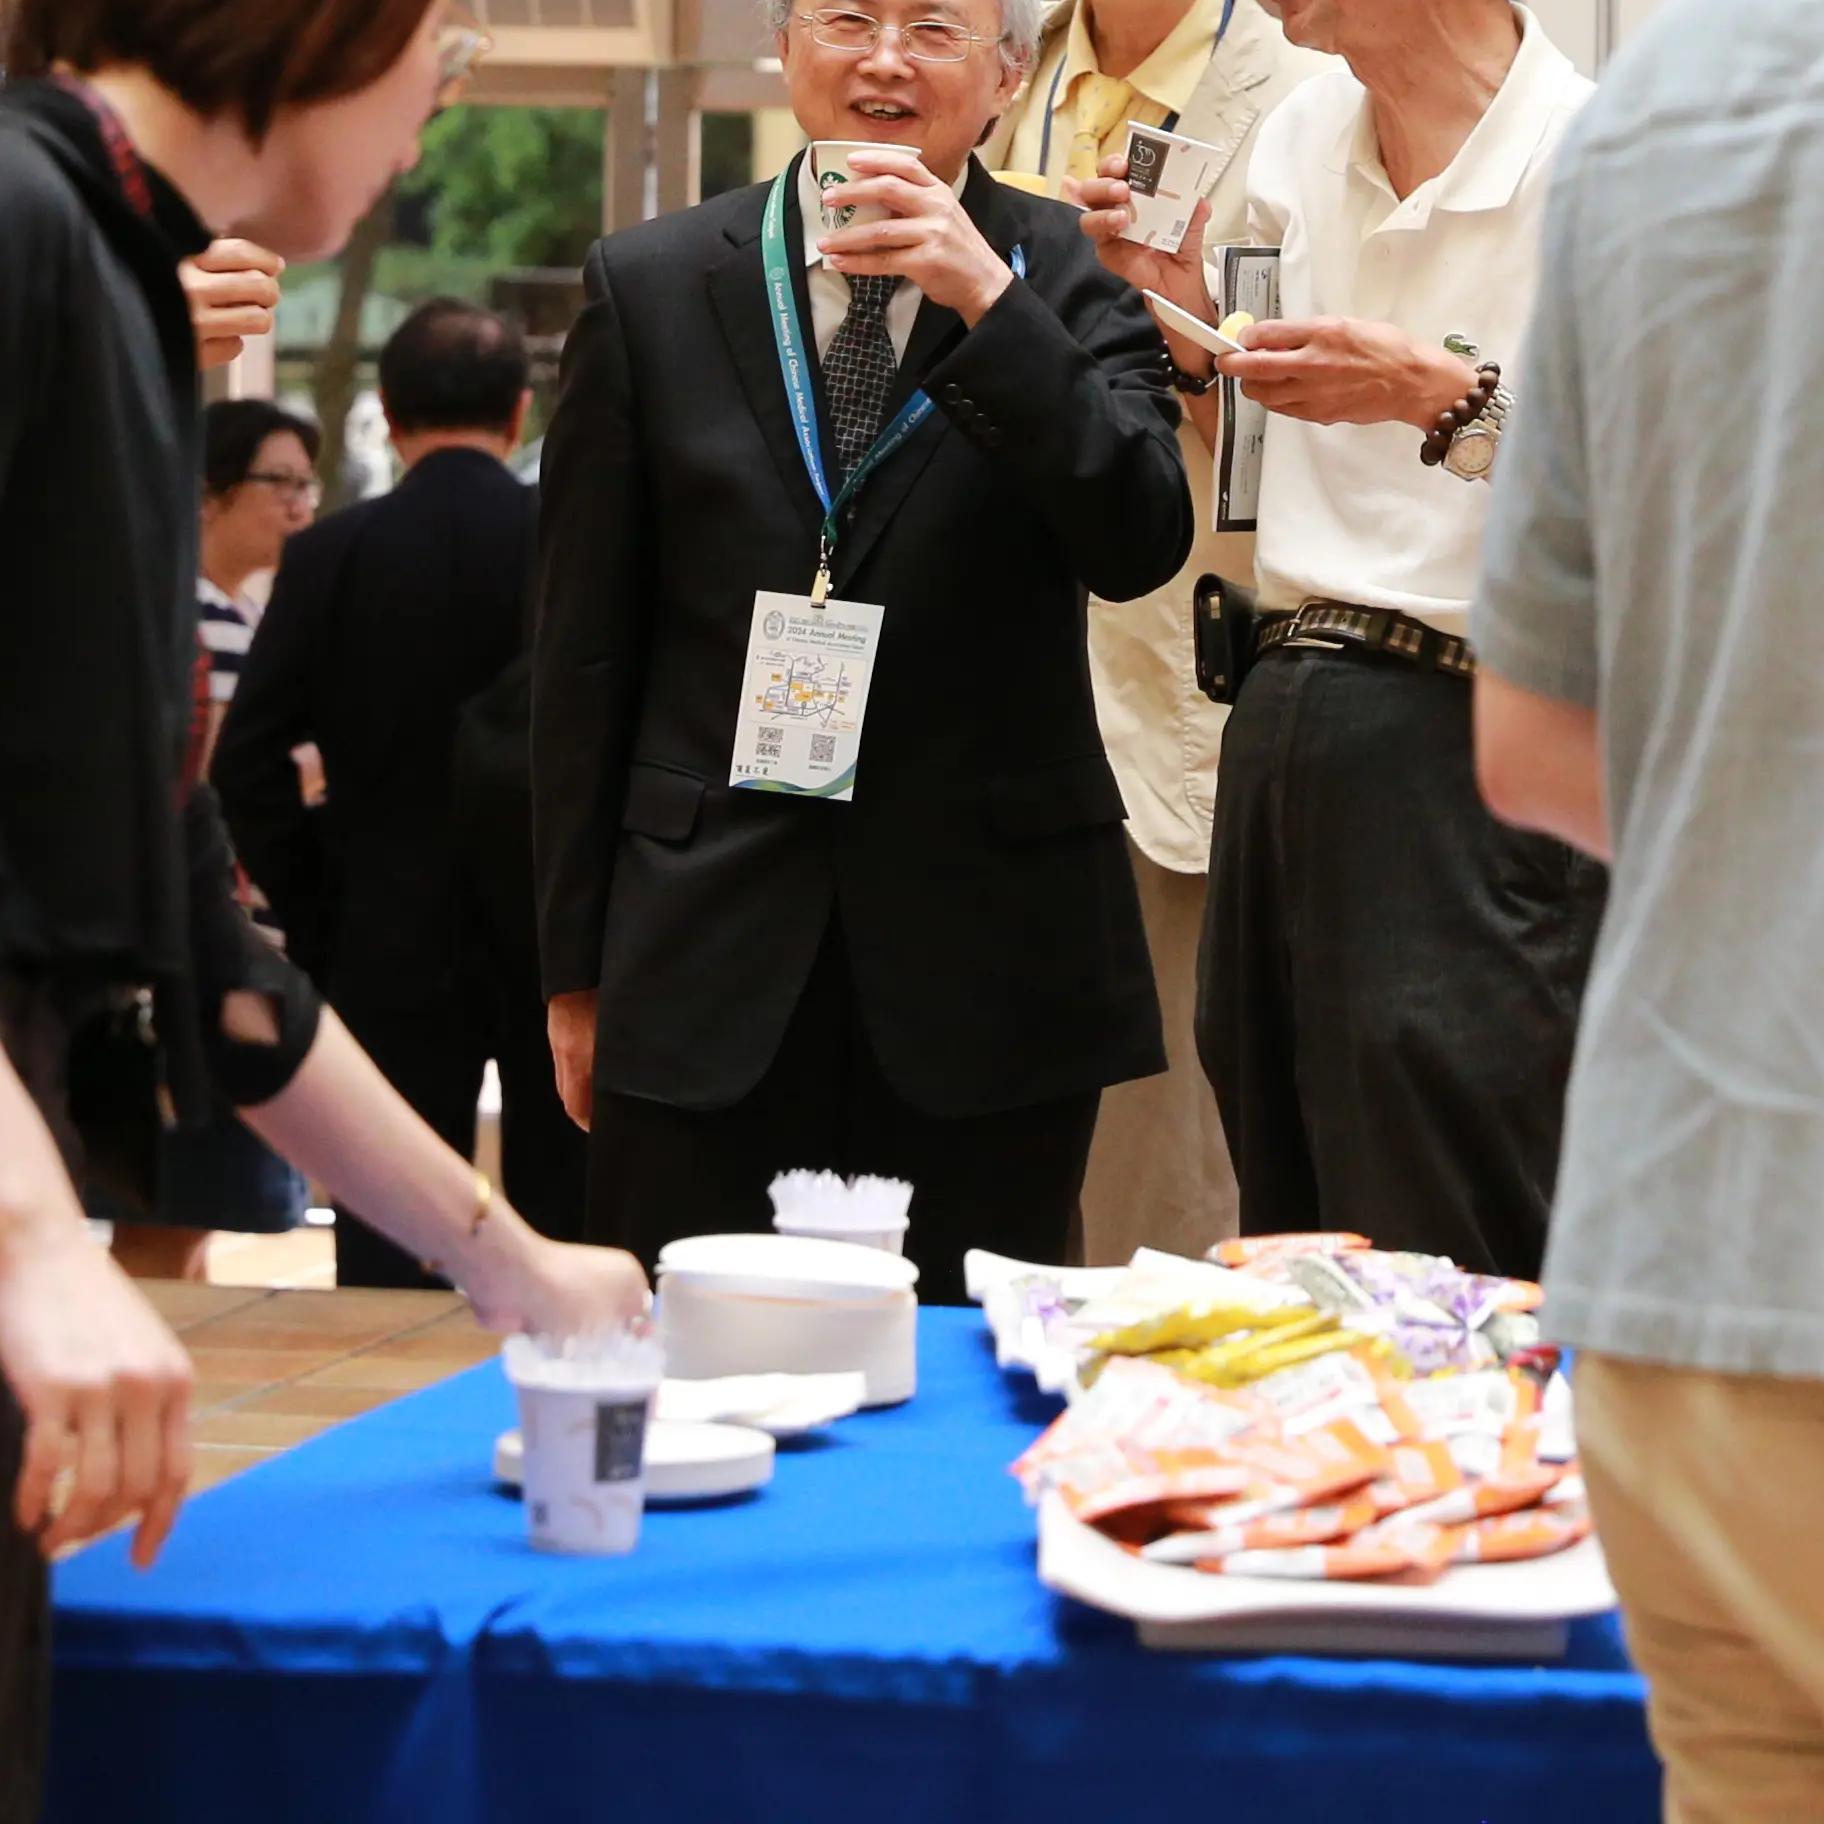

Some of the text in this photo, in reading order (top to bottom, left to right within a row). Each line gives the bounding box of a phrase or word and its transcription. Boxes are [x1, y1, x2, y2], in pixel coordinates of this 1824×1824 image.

[773, 282, 788, 311] Annual
[779, 312, 792, 347] Meeting
[785, 347, 797, 357] of
[788, 358, 801, 390] Chinese
[795, 391, 809, 424] Medical
[787, 625, 867, 645] 2024 Annual Meeting
